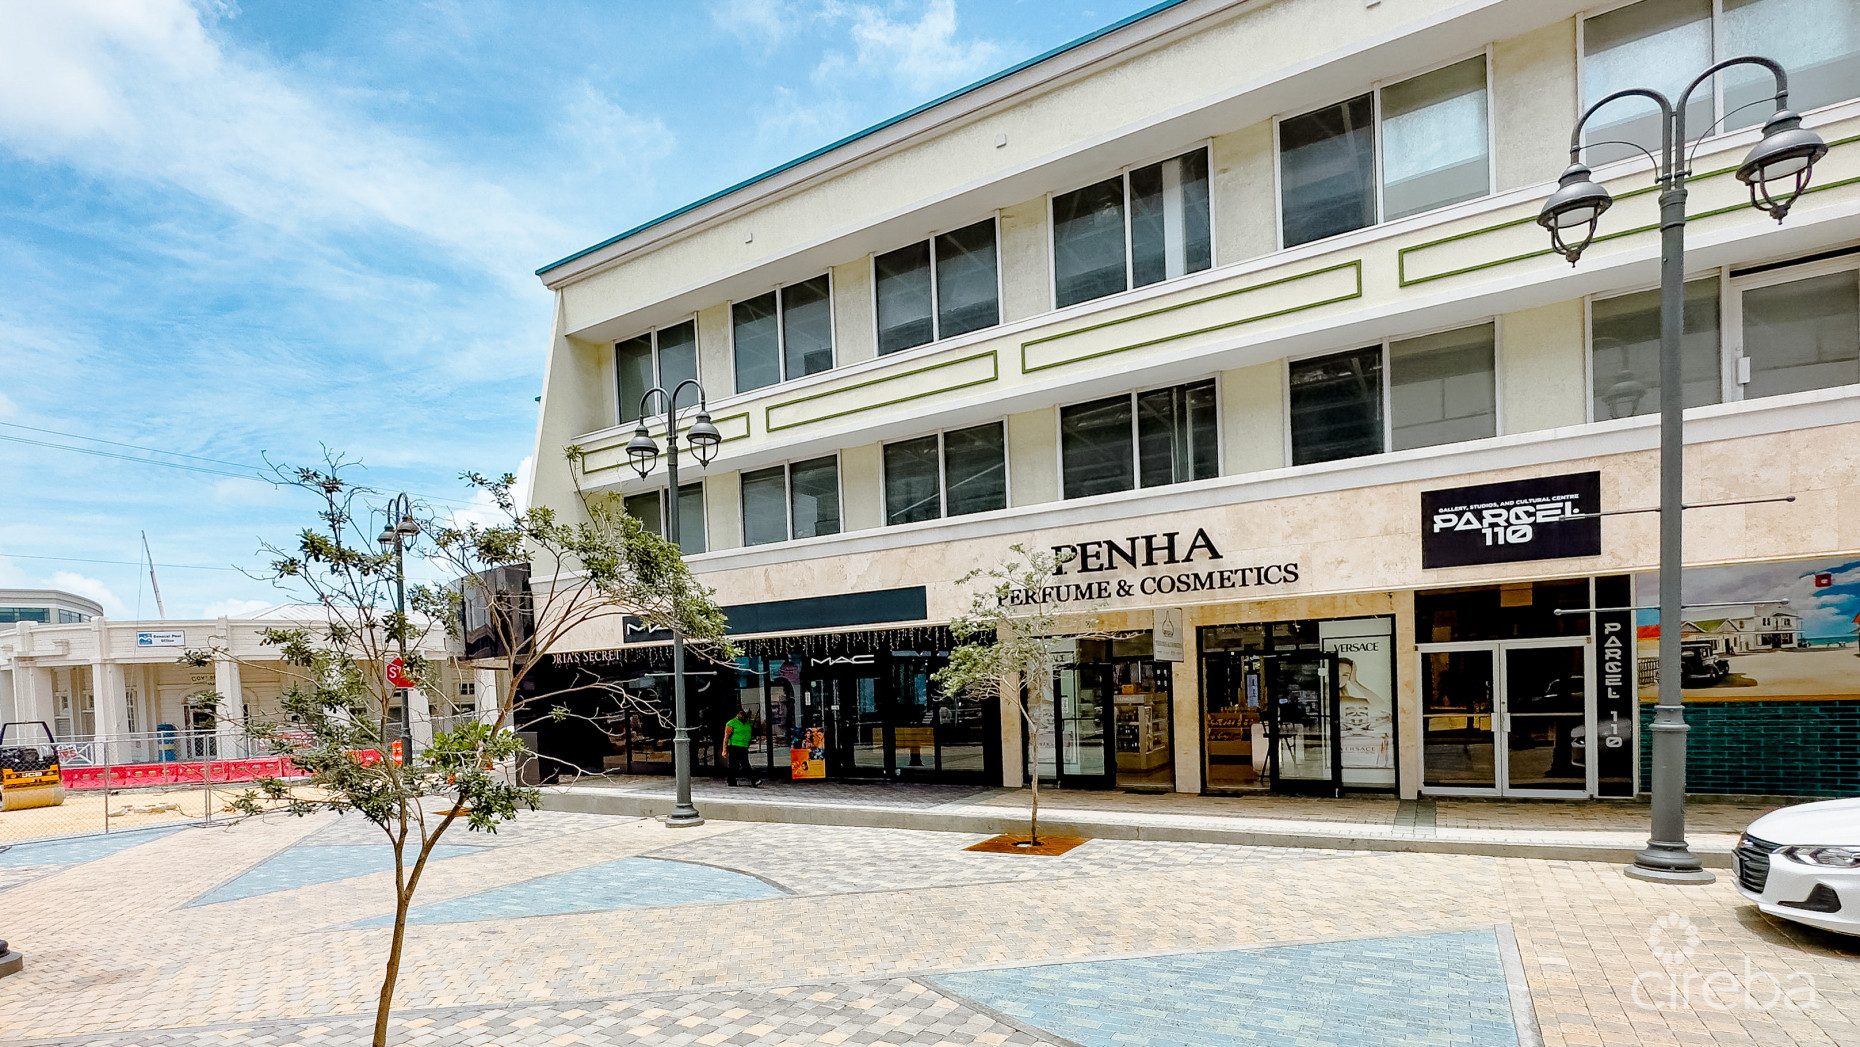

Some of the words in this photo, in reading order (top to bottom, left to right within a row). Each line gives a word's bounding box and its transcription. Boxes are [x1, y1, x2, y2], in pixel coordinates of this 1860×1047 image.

[1438, 505, 1469, 513] GALLERY,
[1469, 502, 1499, 510] STUDIOS,
[1515, 496, 1551, 505] CULTURAL
[1551, 493, 1580, 501] CENTRE
[1433, 501, 1585, 533] PARCEL
[1481, 524, 1533, 546] 110
[1051, 527, 1223, 576] PENHA
[998, 581, 1112, 606] PERFUME
[1116, 579, 1135, 597] &
[1140, 563, 1299, 595] COSMETICS
[583, 650, 621, 662] SECRET
[1333, 642, 1379, 652] VERSACE
[1604, 622, 1622, 699] PARCEL
[811, 655, 875, 667] MAC
[1605, 710, 1623, 748] 110
